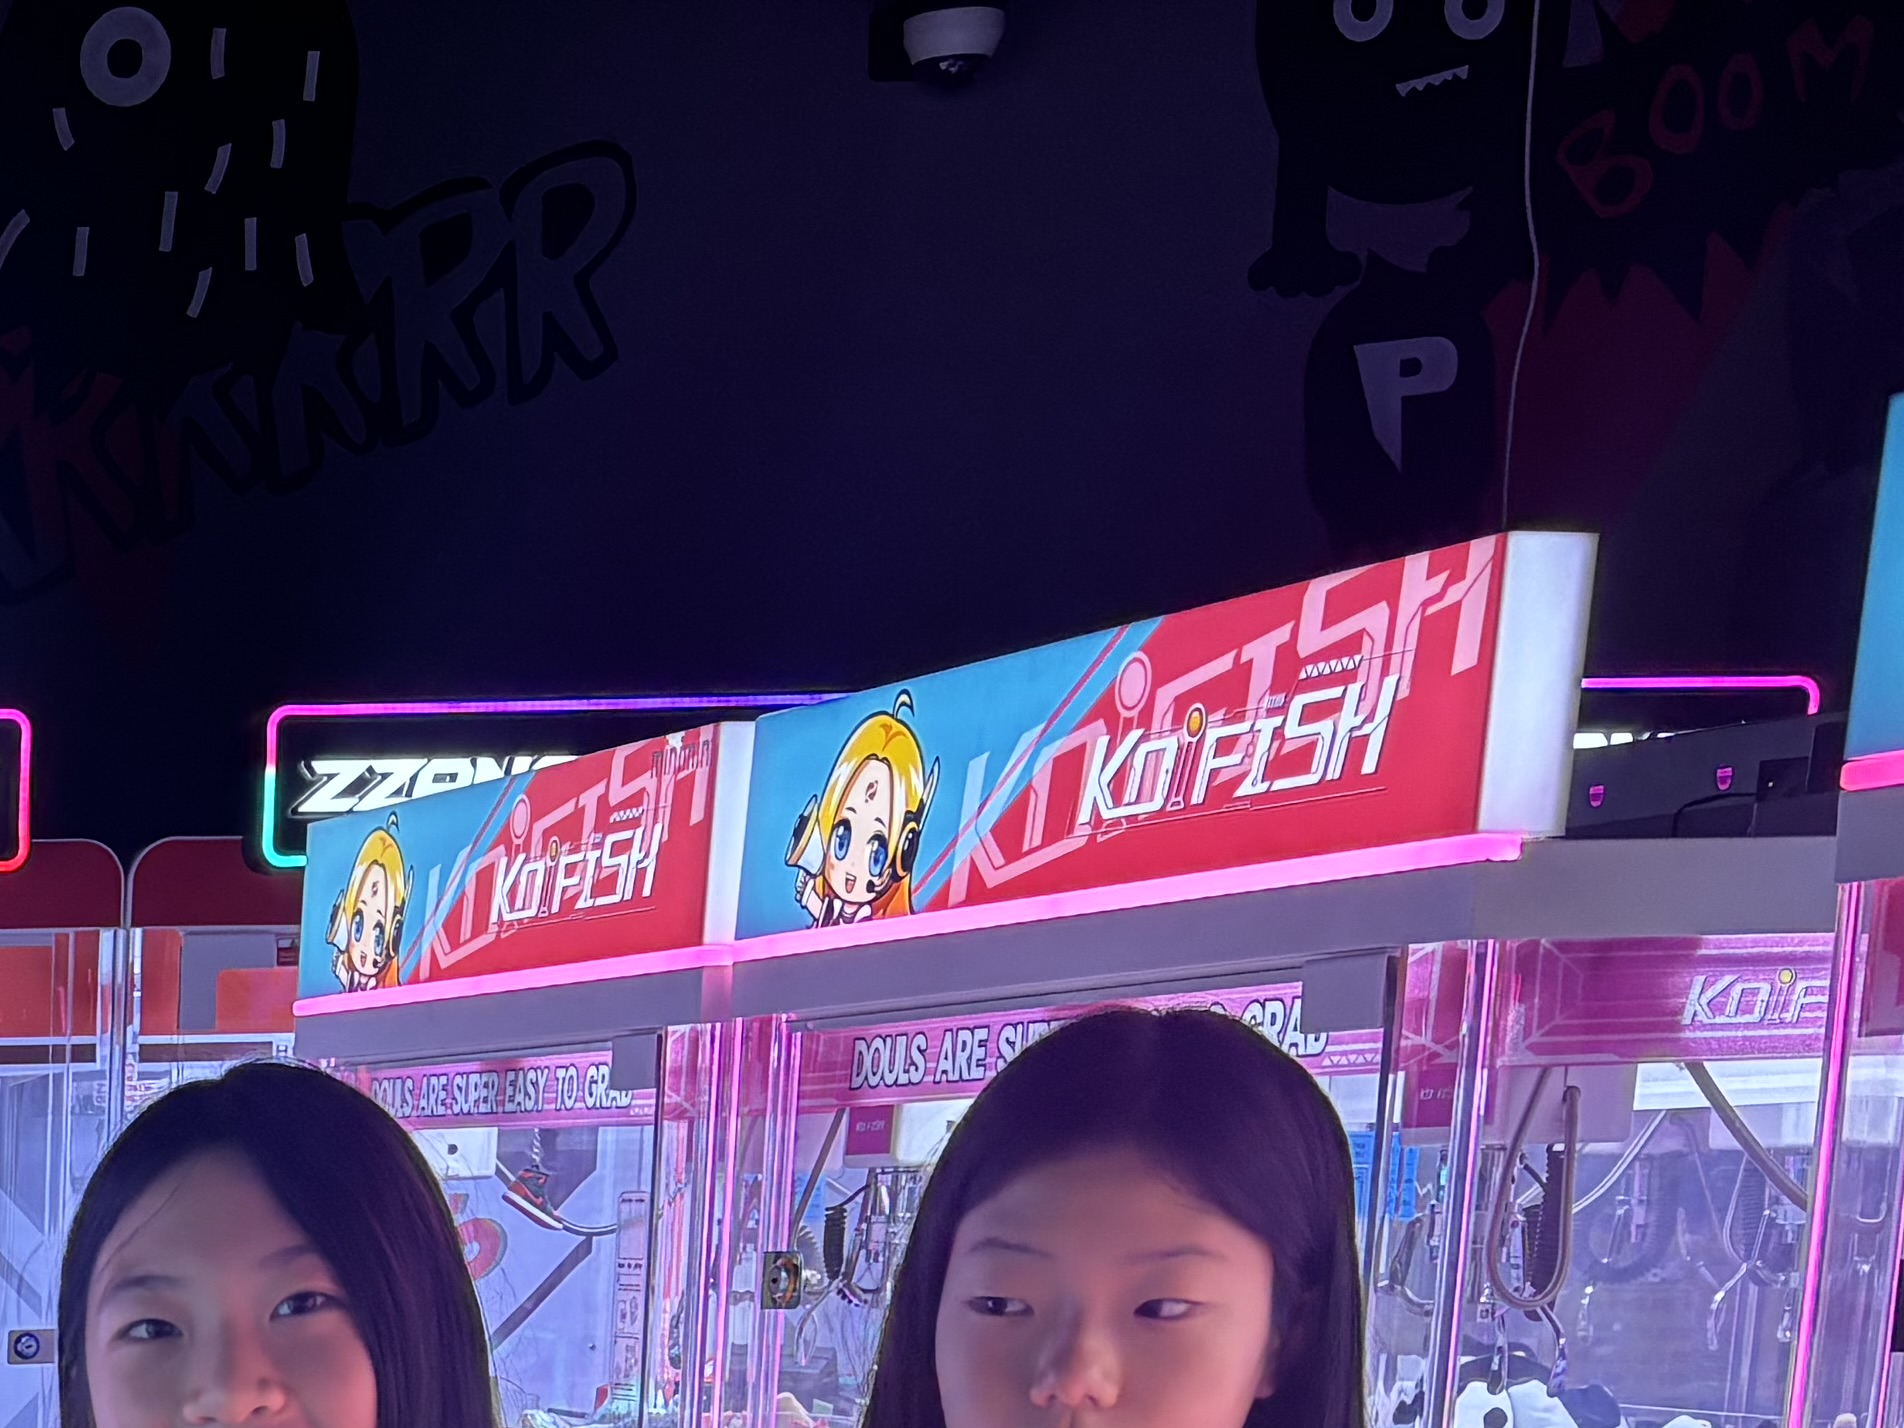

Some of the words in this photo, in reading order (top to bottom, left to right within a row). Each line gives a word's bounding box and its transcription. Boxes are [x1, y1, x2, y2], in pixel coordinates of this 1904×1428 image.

[1683, 967, 1830, 1026] KOIF
[850, 1031, 926, 1090] DOULS
[933, 1027, 986, 1084] ARE
[419, 1074, 449, 1117] ARE
[453, 1070, 499, 1115] SUPER
[504, 1066, 549, 1113] EASY
[555, 1063, 578, 1111] TO
